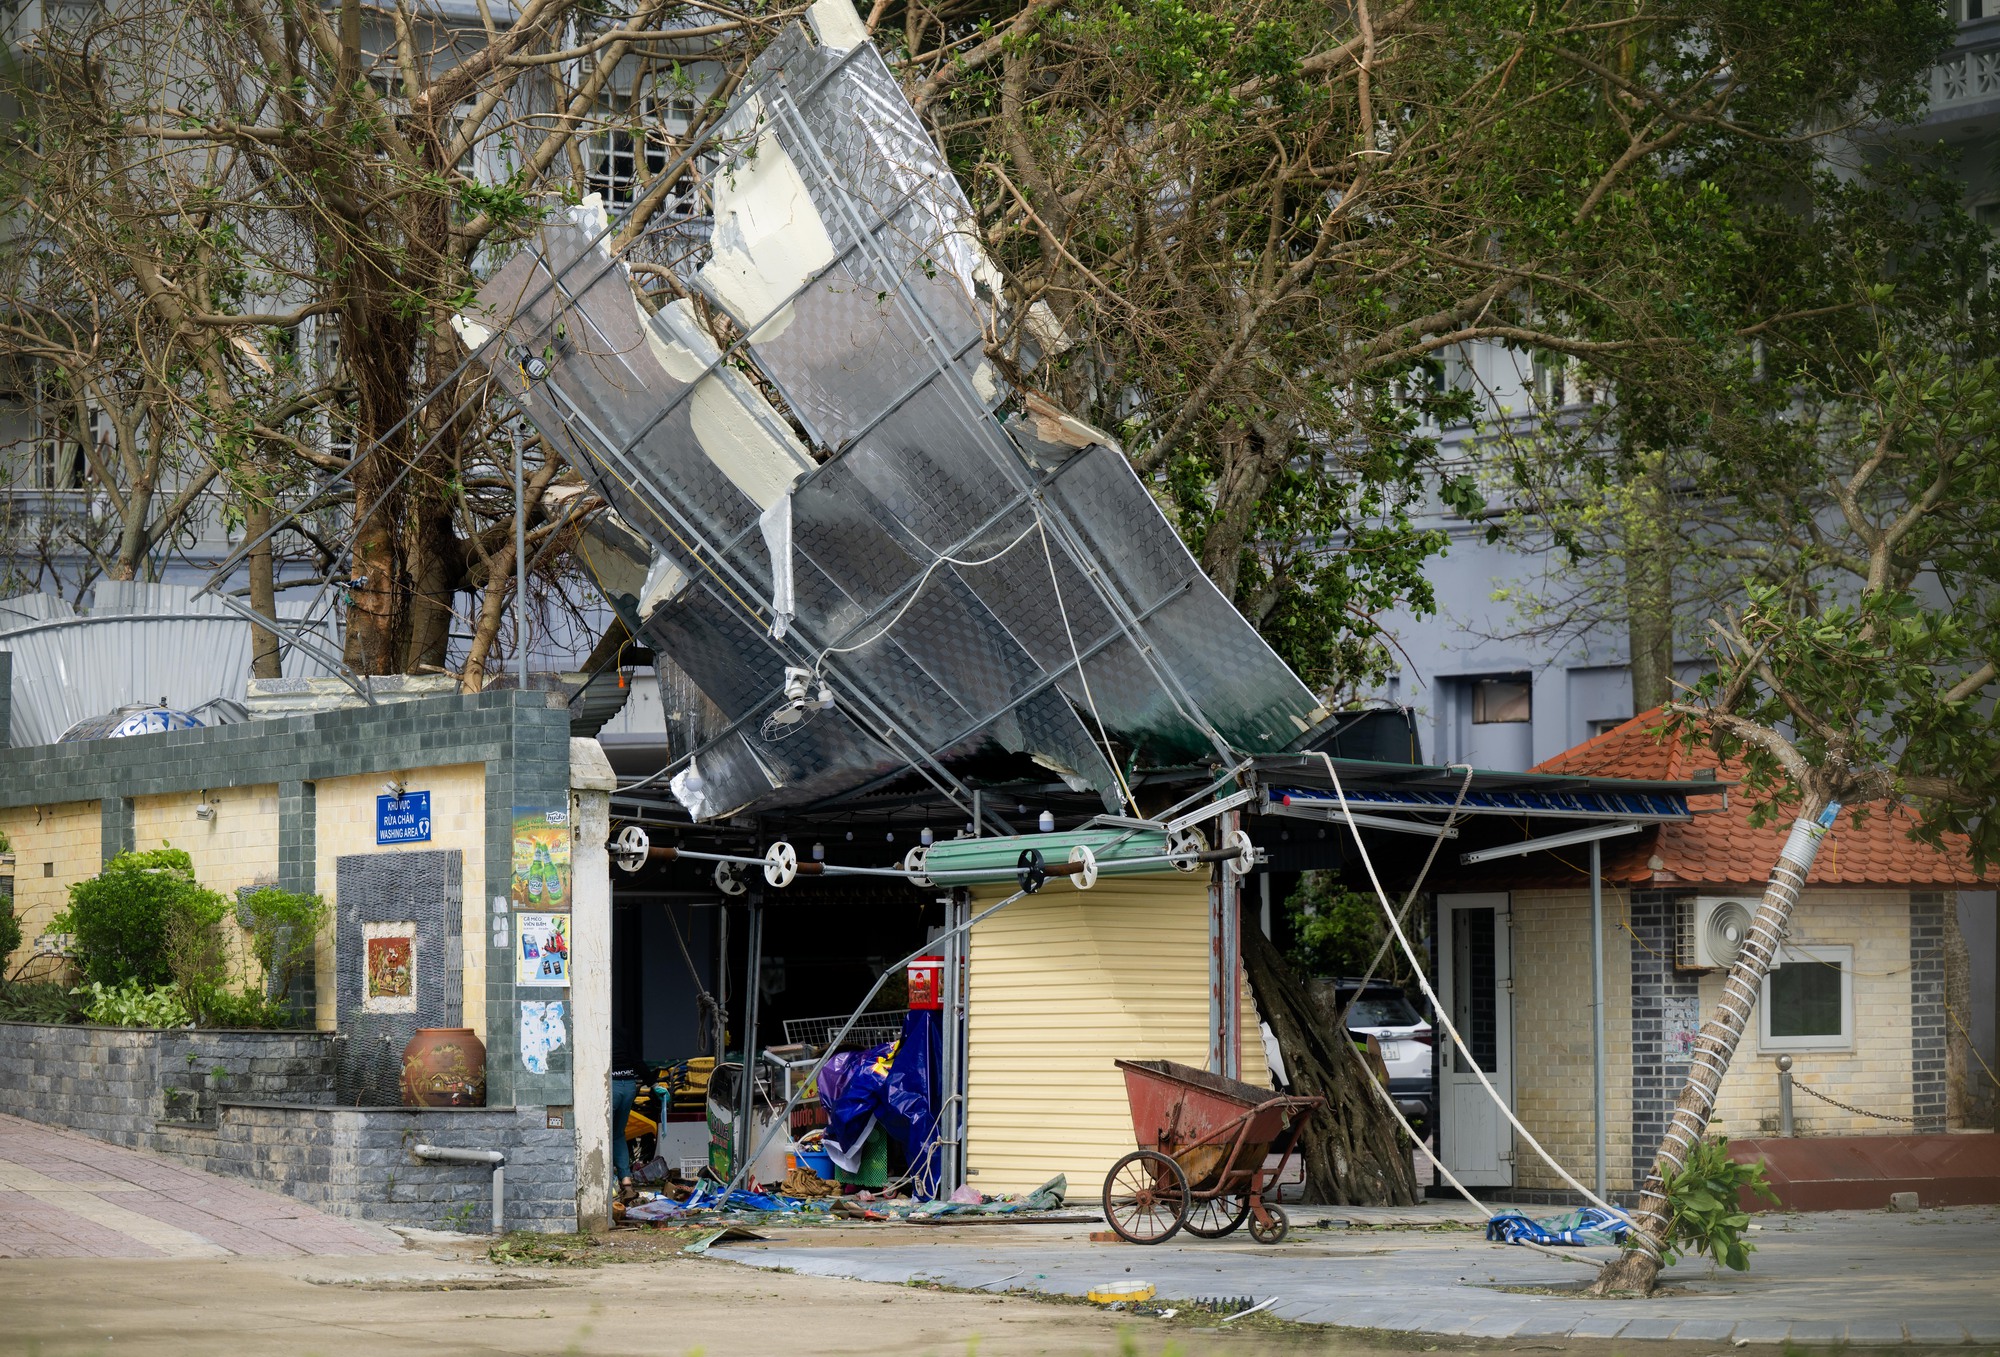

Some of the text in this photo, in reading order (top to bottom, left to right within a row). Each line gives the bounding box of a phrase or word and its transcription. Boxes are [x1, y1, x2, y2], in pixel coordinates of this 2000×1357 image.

[388, 800, 410, 812] KHU VỰC
[384, 814, 397, 826] RỬA
[380, 827, 418, 839] WASHING AREA
